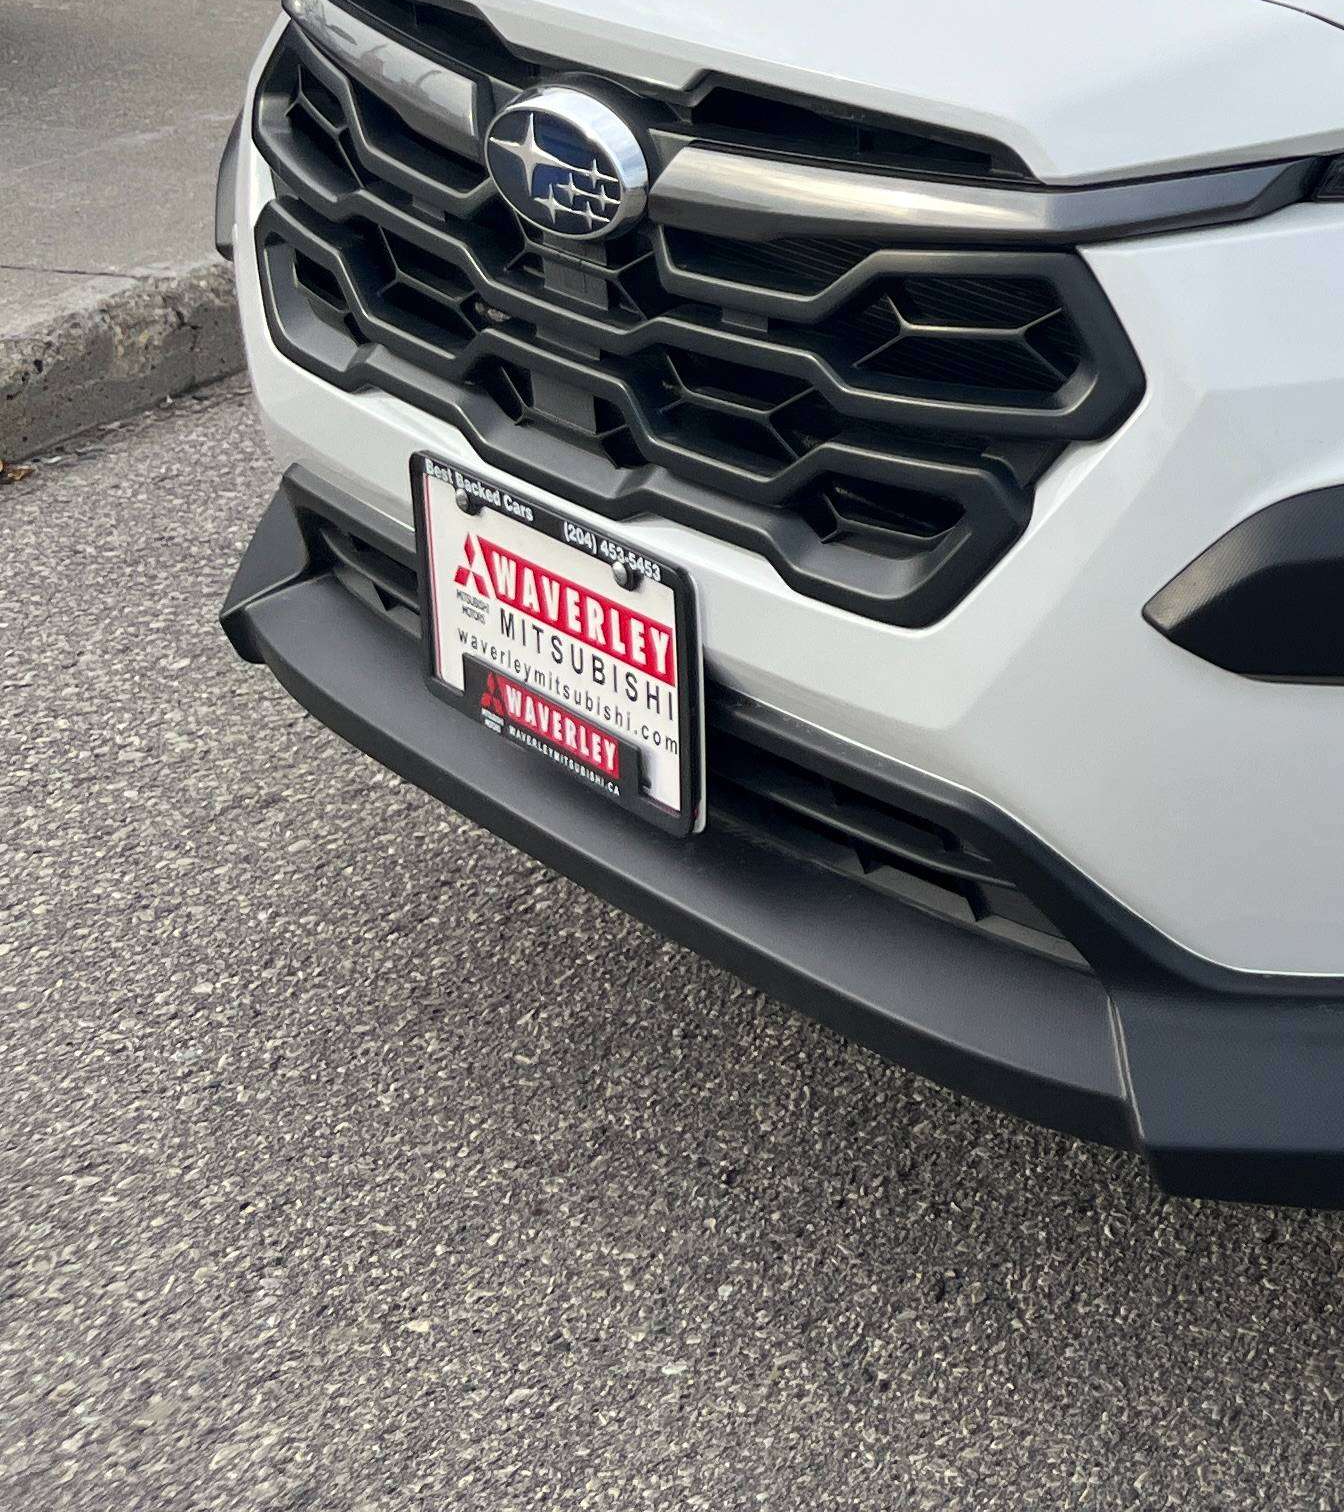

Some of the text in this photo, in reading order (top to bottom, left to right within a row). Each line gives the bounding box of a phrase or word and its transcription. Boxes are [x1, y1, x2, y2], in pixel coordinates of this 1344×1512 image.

[426, 459, 534, 522] Best Backed Cars
[563, 521, 661, 582] (204) 453-5453
[492, 551, 672, 675] WAVERLEY
[458, 627, 678, 755] waverleymitsubishi.com
[500, 608, 674, 721] MITSUBISHI
[505, 684, 616, 771] WAVERLEY
